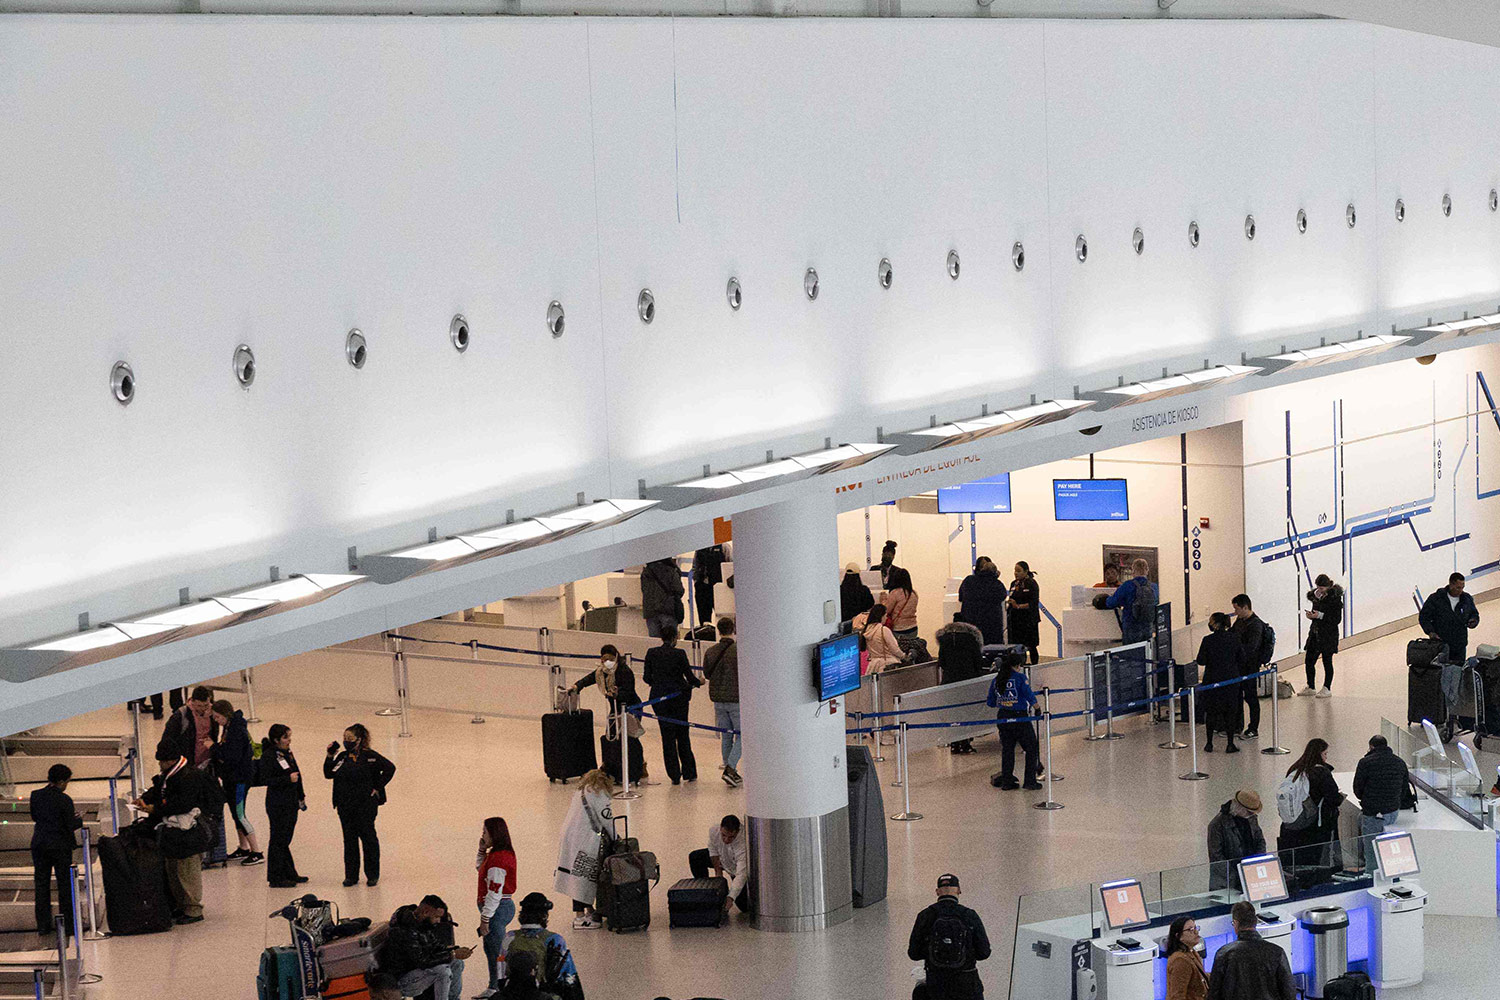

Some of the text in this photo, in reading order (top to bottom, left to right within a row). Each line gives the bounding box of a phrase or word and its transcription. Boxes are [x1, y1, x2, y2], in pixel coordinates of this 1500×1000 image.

[1132, 405, 1199, 432] ASISTENCIA DE KIOSCO
